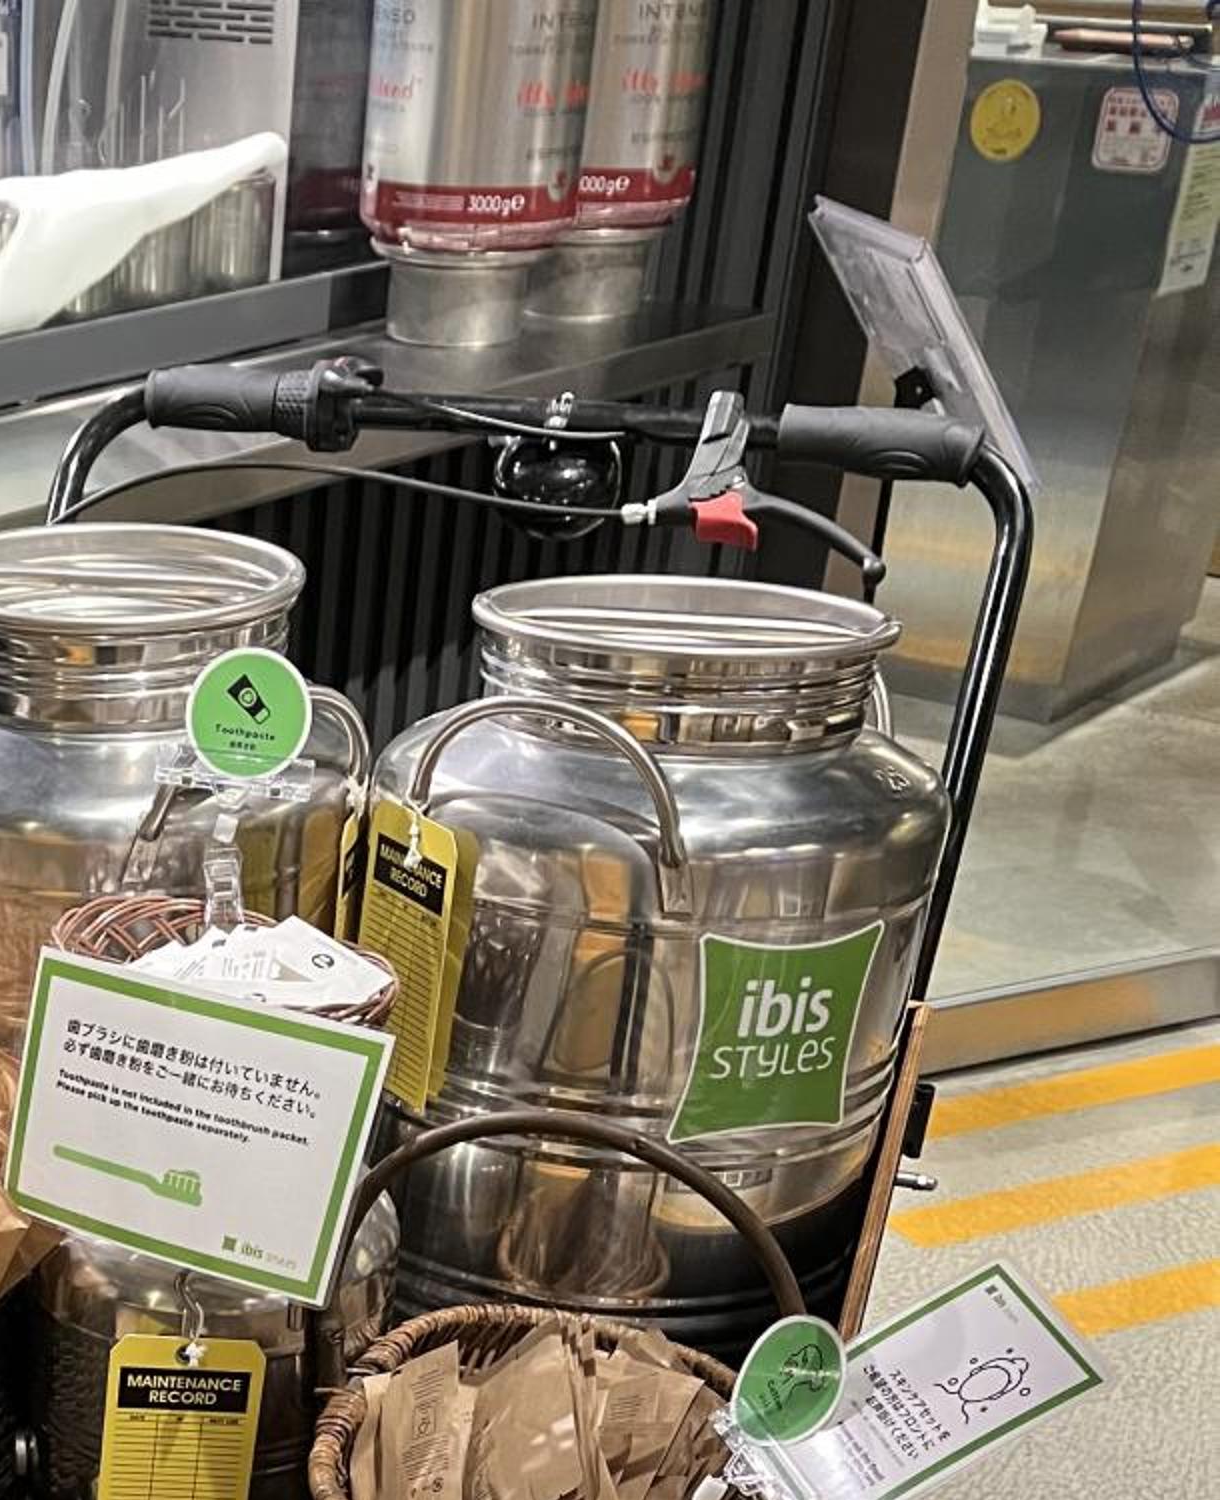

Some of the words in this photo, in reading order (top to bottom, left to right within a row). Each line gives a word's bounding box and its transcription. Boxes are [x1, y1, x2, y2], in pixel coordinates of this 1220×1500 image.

[216, 723, 275, 741] Toothpaste
[390, 866, 428, 897] RECORD
[737, 976, 834, 1038] ibis
[56, 1080, 86, 1096] Please
[87, 1090, 107, 1103] pick
[109, 1097, 122, 1107] up
[123, 1100, 139, 1112] the
[141, 1105, 194, 1127] toothpaste
[60, 1068, 109, 1091] Toothpaste
[111, 1083, 120, 1095] is
[121, 1089, 138, 1100] not
[140, 1092, 181, 1113] included
[183, 1105, 193, 1115] in
[195, 1108, 211, 1120] the
[213, 1112, 271, 1135] toothbrush
[126, 1373, 244, 1393] MAINTENANCE
[148, 1389, 218, 1406] RECORD
